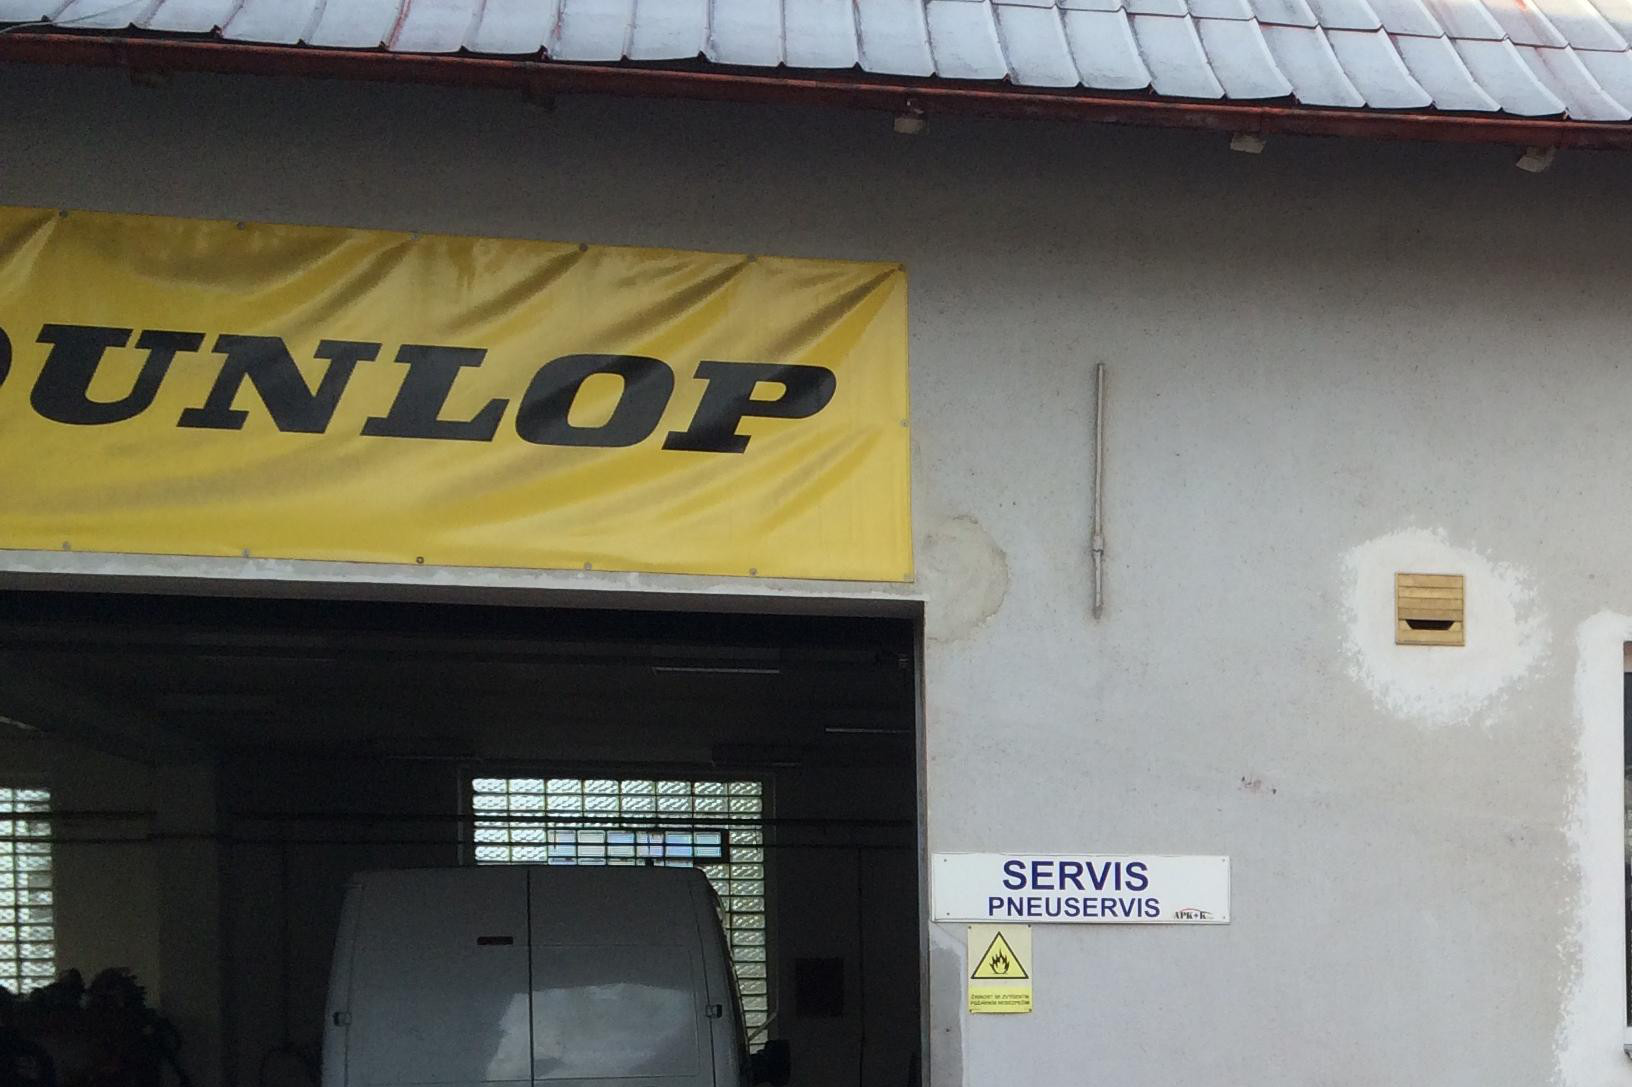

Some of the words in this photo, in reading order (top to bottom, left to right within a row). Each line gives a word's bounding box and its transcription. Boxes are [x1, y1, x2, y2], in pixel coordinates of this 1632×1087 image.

[0, 323, 837, 454] UNLOP
[1002, 859, 1149, 891] SERVIS
[988, 896, 1160, 918] PNEUSERVIS
